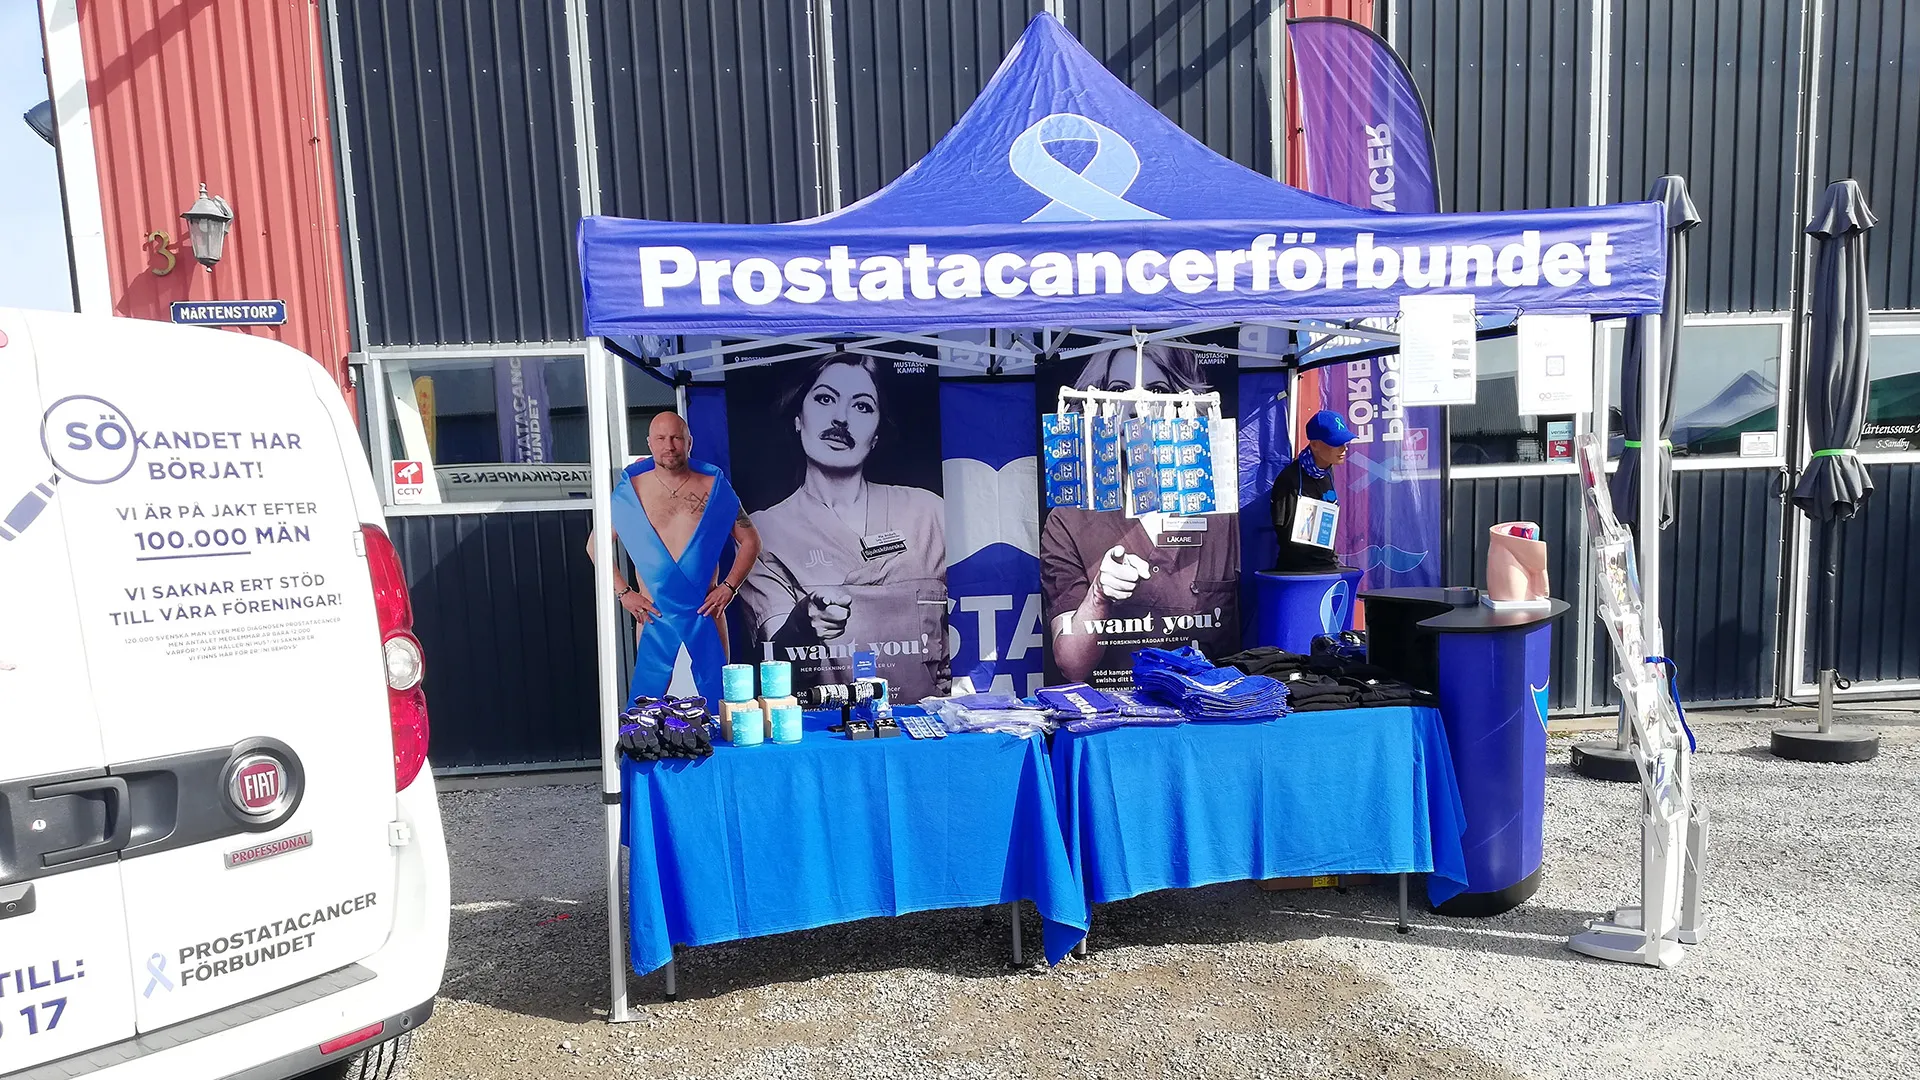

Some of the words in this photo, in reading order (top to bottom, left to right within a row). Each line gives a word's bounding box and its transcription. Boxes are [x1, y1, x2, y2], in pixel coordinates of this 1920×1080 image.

[148, 230, 176, 276] 3
[639, 229, 1612, 308] Prostatacancerförbundet
[897, 366, 925, 374] KAMPEN
[250, 431, 302, 450] HAR
[147, 456, 264, 480] BÖRJAT!
[397, 487, 423, 496] CCTV
[116, 506, 138, 521] VI
[145, 503, 172, 520] ÄR
[178, 501, 205, 519] PÅ
[211, 503, 257, 518] JAKT
[263, 501, 318, 516] EFTER
[134, 527, 247, 551] 100.000
[255, 521, 311, 544] MÄN
[124, 586, 146, 602] VI
[152, 580, 235, 600] SAKNAR
[240, 577, 274, 593] ERT
[280, 571, 326, 589] STÖD
[109, 609, 154, 626] TILL
[159, 602, 217, 621] VÅRA
[222, 593, 342, 616] FÖRENINGAR!
[1060, 612, 1075, 636] I
[1083, 611, 1154, 636] want
[1162, 607, 1223, 636] you!
[760, 641, 775, 661] I
[785, 638, 858, 661] want
[867, 633, 929, 660] you!
[244, 771, 277, 802] FIAT
[231, 834, 309, 865] PROFESSIONAL
[178, 891, 377, 964] PROSTATACANCER
[180, 931, 316, 987] FÖRBUNDET
